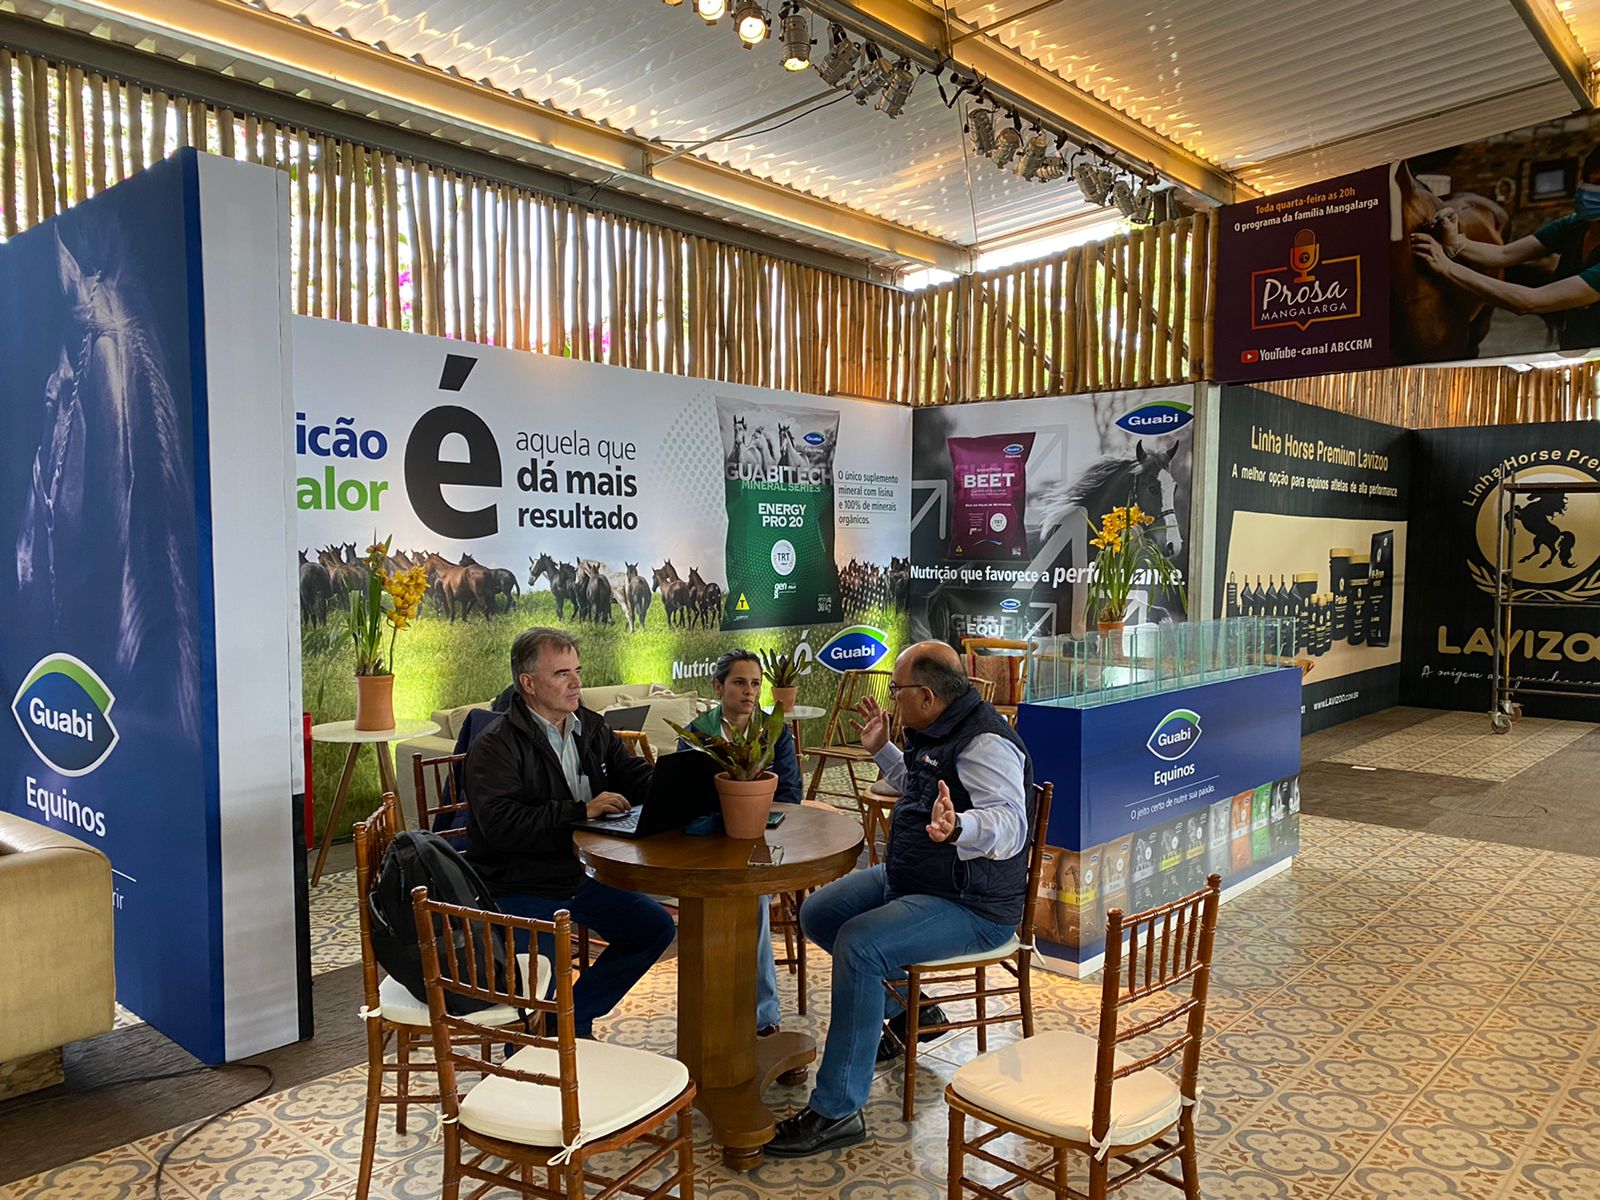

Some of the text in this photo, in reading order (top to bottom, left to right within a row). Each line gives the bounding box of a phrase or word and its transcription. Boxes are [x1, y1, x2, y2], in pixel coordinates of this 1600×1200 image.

[1255, 187, 1356, 215] Toda quarta-feira as 20h
[1234, 197, 1379, 232] O programa da família Mangalarga
[1262, 278, 1349, 311] Prosa
[1261, 302, 1348, 321] MANGALARGA
[1259, 338, 1373, 361] YouTube-canal ABCCRM
[1127, 413, 1179, 426] Guabi
[403, 353, 503, 540] é
[515, 430, 590, 459] aquela
[597, 437, 637, 464] que
[1251, 425, 1389, 472] Linha Horse Premium Lavizoo
[516, 458, 638, 498] dá mais
[725, 462, 834, 486] GUABITECH
[838, 470, 899, 484] O único suplemento
[963, 473, 1015, 488] BEET
[1231, 463, 1398, 498] A melhor opção para equinos atletas de alta performance
[1462, 449, 1600, 508] Linha Horse Pre
[741, 480, 821, 493] MINERAL SERIES
[838, 485, 894, 497] mineral com lisina
[518, 502, 639, 531] resultado
[758, 502, 807, 516] ENERGY
[838, 500, 897, 512] e 100% de minerais
[762, 516, 804, 528] PRO 20
[776, 552, 790, 562] TRT
[910, 565, 958, 582] Nutrição
[960, 569, 983, 584] que
[985, 568, 1039, 583] favorece
[1041, 571, 1050, 583] a
[966, 623, 1004, 637] EQUI
[831, 644, 876, 660] Guabi
[1420, 665, 1434, 678] A
[28, 697, 94, 742] Guabi
[1157, 727, 1191, 746] Guabi
[1154, 763, 1195, 786] Equinos
[25, 776, 106, 838] Equinos
[1130, 809, 1137, 820] O
[1137, 807, 1150, 821] jeito
[1150, 802, 1165, 813] certo
[1165, 798, 1173, 807] de
[1173, 794, 1188, 805] nutrir
[1188, 791, 1198, 801] sua
